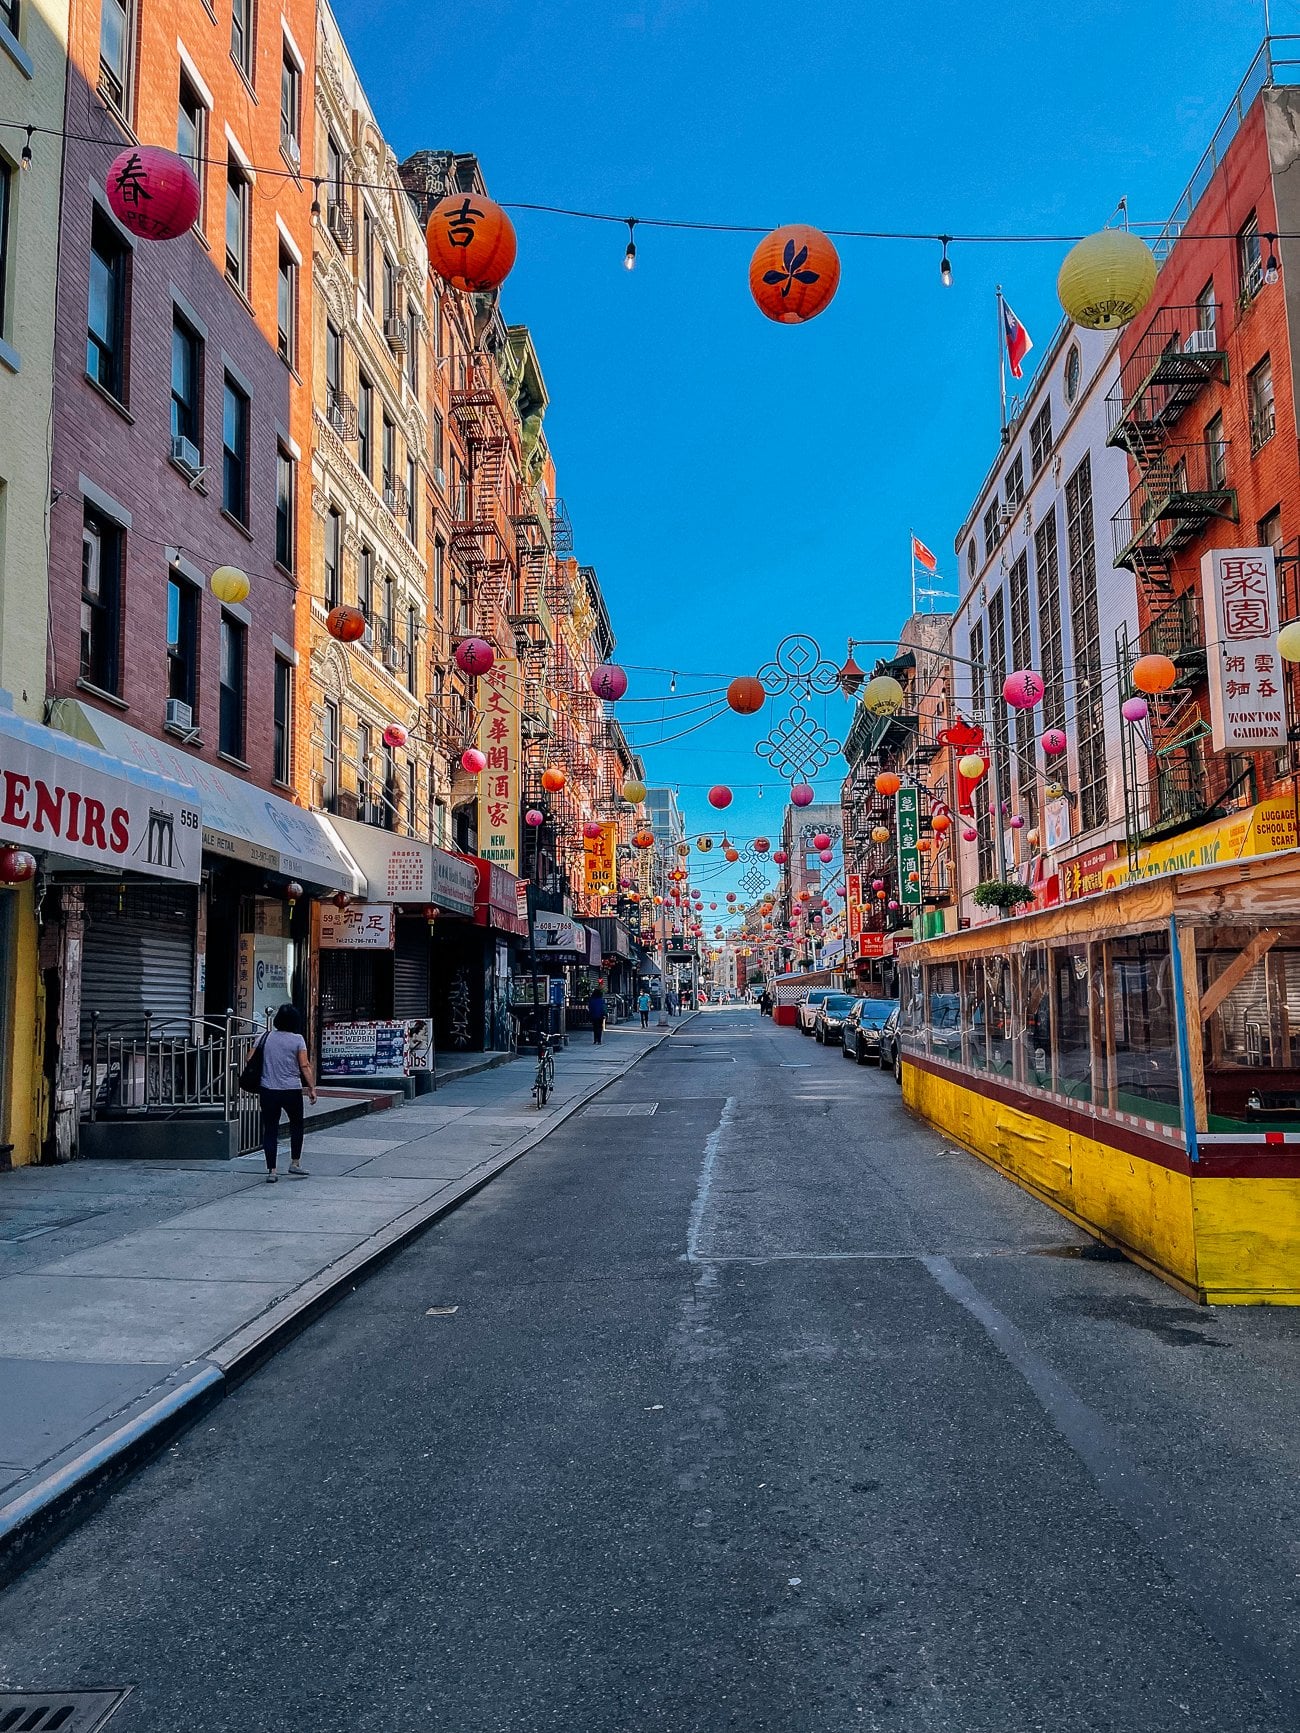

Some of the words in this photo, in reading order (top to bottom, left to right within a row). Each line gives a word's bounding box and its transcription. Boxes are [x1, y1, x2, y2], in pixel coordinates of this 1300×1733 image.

[114, 153, 154, 208] 春
[444, 198, 485, 247] 吉
[463, 643, 478, 664] 春
[598, 673, 614, 695] 春
[1023, 674, 1040, 697] 春
[1228, 711, 1281, 724] WONTON
[1233, 726, 1279, 739] GARDEN
[0, 770, 129, 854] ENIRS
[1261, 810, 1295, 821] LUGGAGE
[180, 809, 199, 829] 55B
[1256, 823, 1285, 835] SCHOOL
[216, 837, 236, 853] RETAIL
[491, 835, 505, 846] NEW
[1271, 835, 1294, 846] SCARF
[481, 849, 515, 860] MANDARIN
[592, 871, 609, 880] BIG
[345, 1035, 376, 1043] WEPRIN
